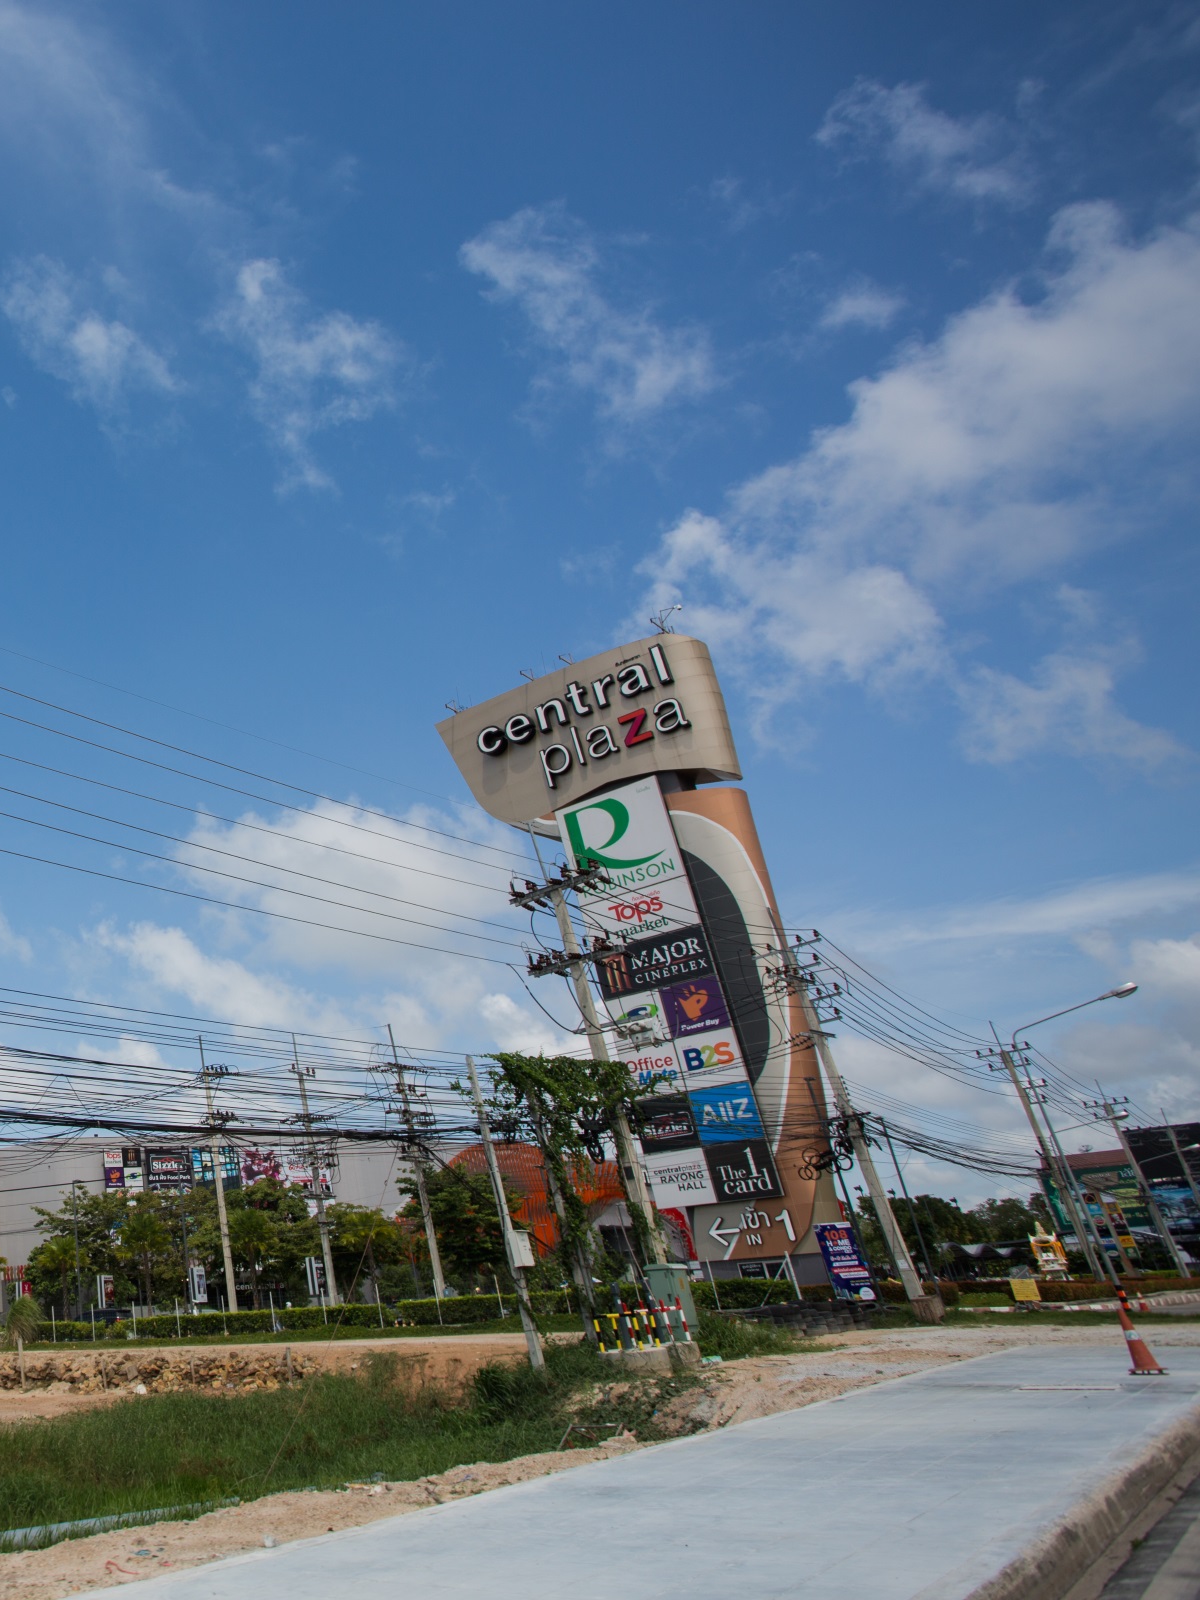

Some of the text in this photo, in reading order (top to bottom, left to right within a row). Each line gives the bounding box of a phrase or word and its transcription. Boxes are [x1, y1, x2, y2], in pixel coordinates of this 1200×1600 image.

[477, 644, 674, 756] central
[539, 698, 691, 788] plaza
[583, 858, 675, 898] ROBINSON
[608, 896, 664, 922] Tops
[614, 915, 669, 940] market
[631, 937, 703, 970] MAJOR
[634, 958, 708, 984] CINEPLEX
[681, 1018, 720, 1031] Power Buy
[626, 1056, 673, 1074] Office
[682, 1042, 734, 1071] B2S
[105, 1152, 121, 1160] Tops
[716, 1146, 762, 1181] The 1
[654, 1164, 702, 1176] centralplaza
[660, 1171, 704, 1184] RAYONG
[724, 1168, 774, 1195] card
[678, 1181, 706, 1192] HALL
[740, 1206, 771, 1230] เข้า
[774, 1208, 796, 1242] 1
[746, 1233, 762, 1246] IN
[824, 1230, 848, 1240] 108
